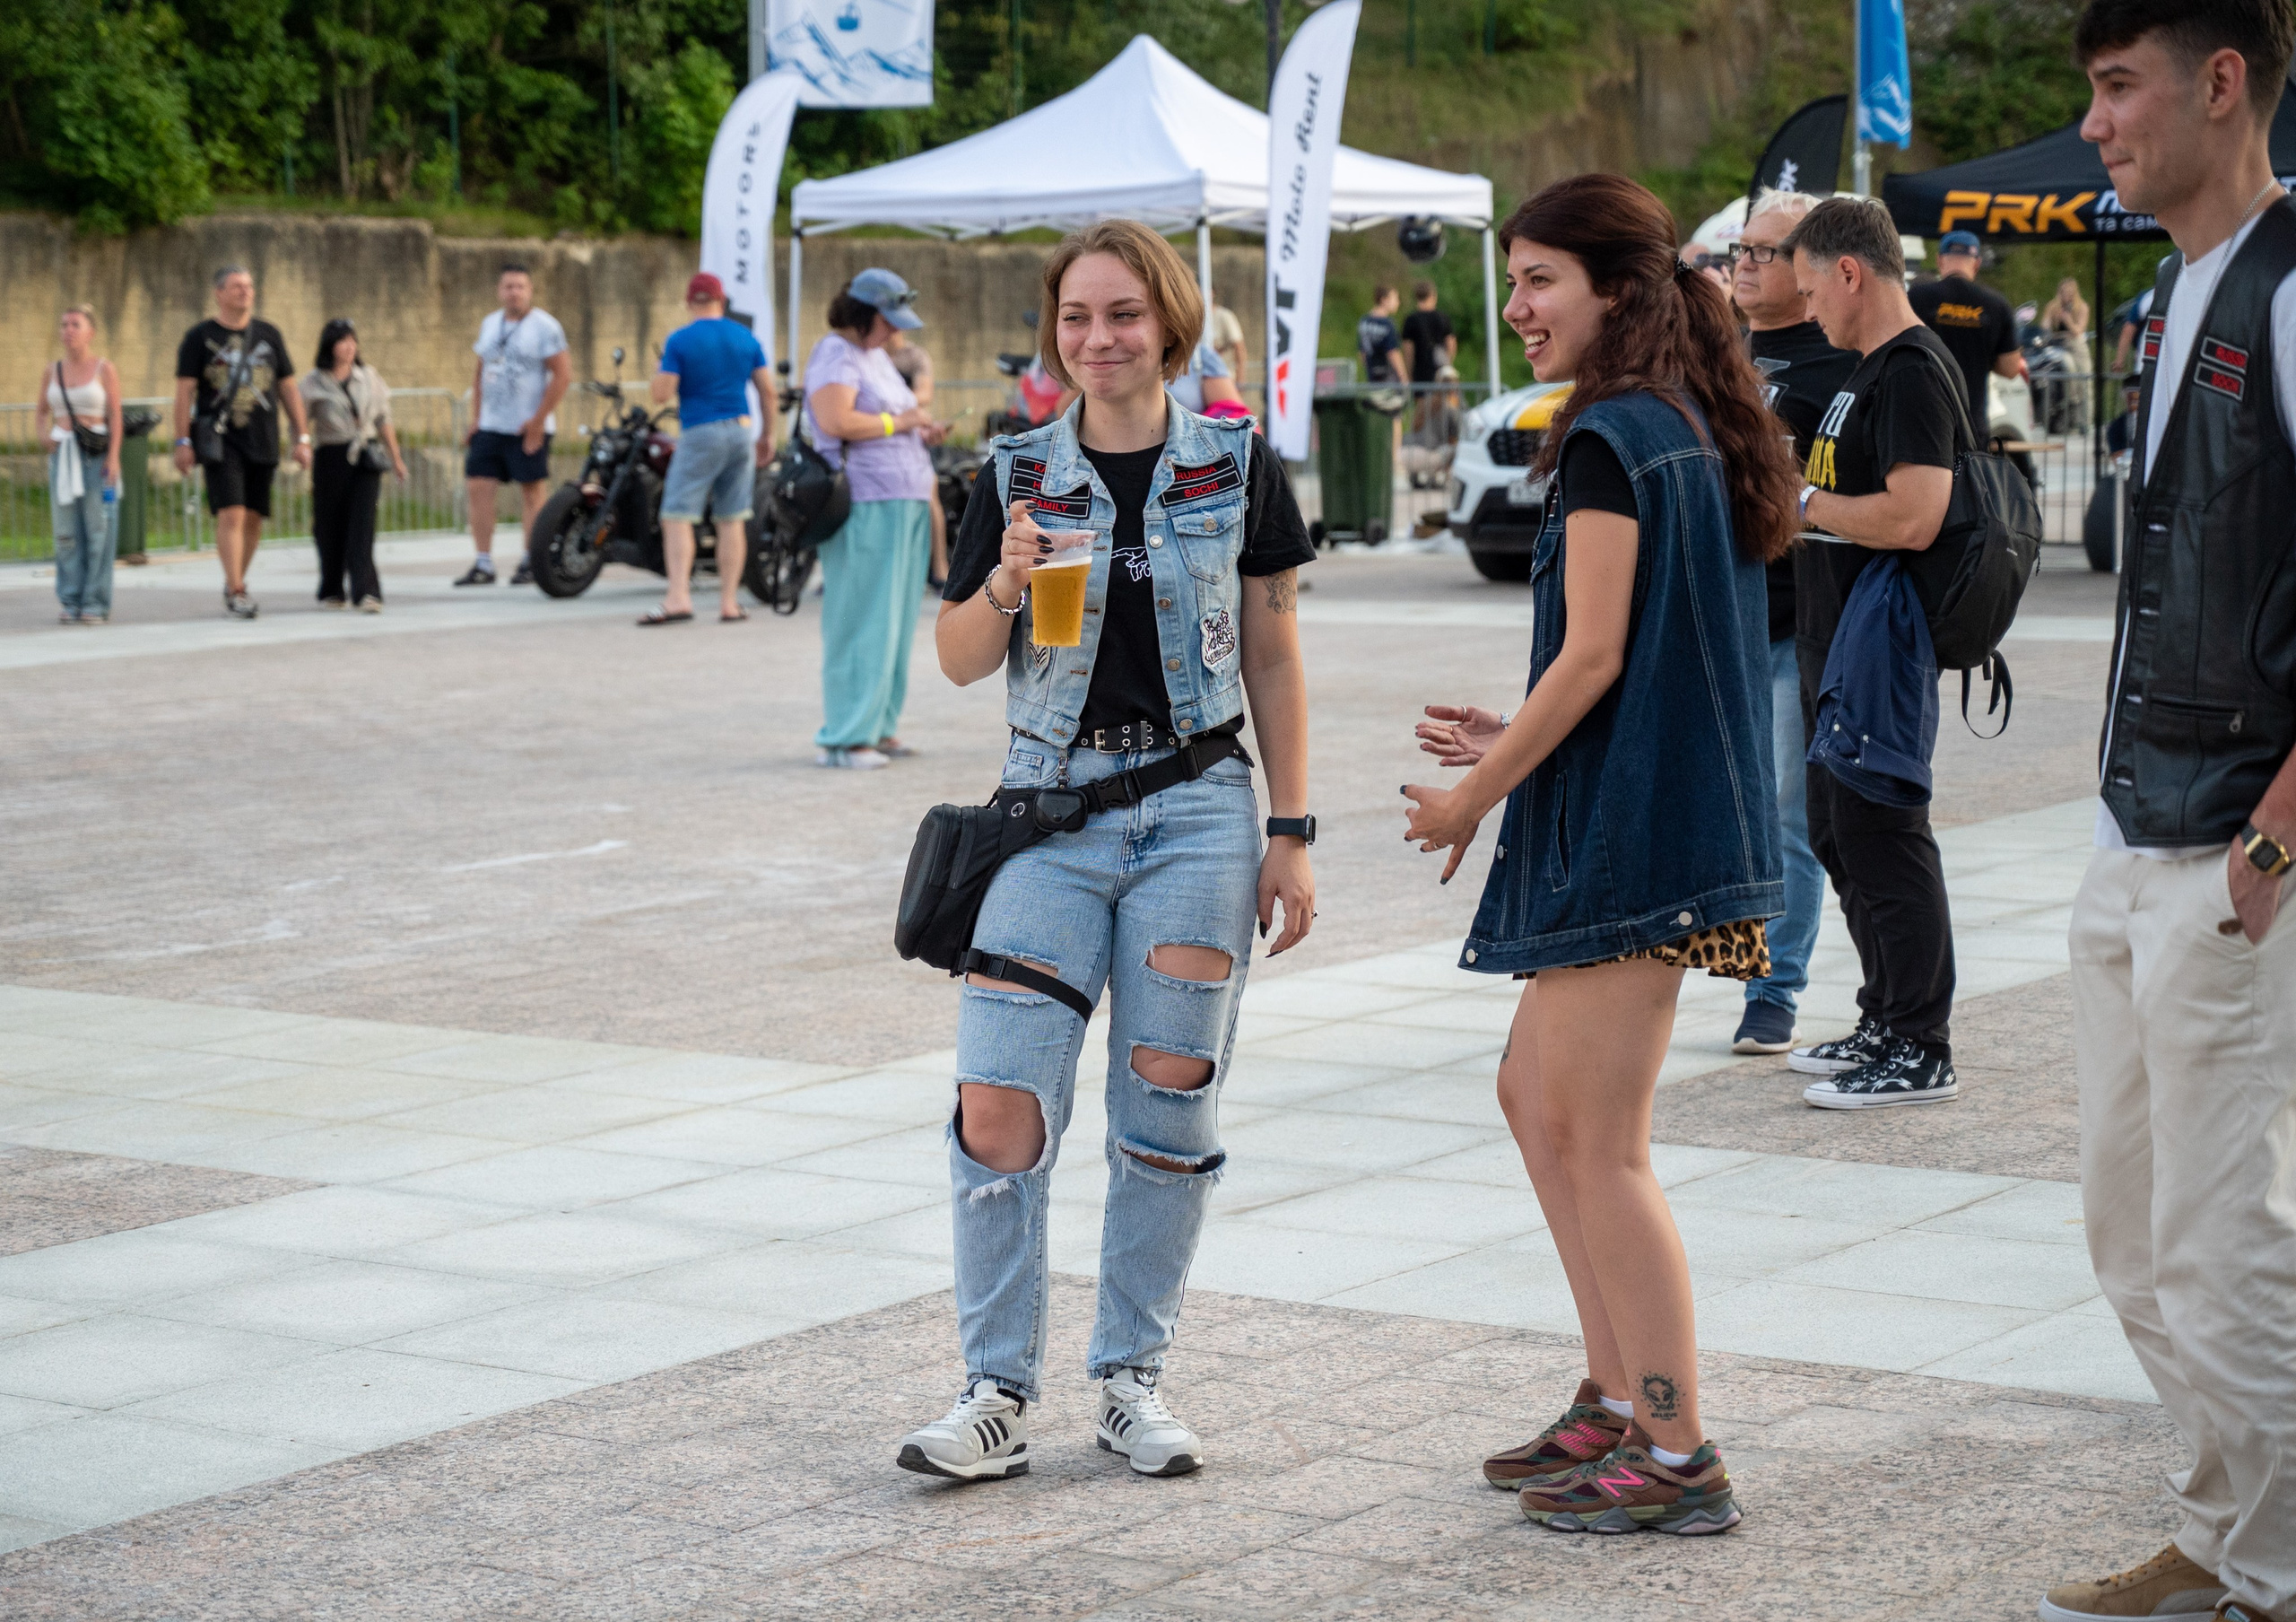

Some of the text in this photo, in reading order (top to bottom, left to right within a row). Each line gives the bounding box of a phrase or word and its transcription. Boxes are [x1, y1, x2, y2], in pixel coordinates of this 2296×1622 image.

[1938, 189, 2099, 233] PRK
[1175, 466, 1218, 481] RUSSIA
[1184, 481, 1220, 498] SOCHI
